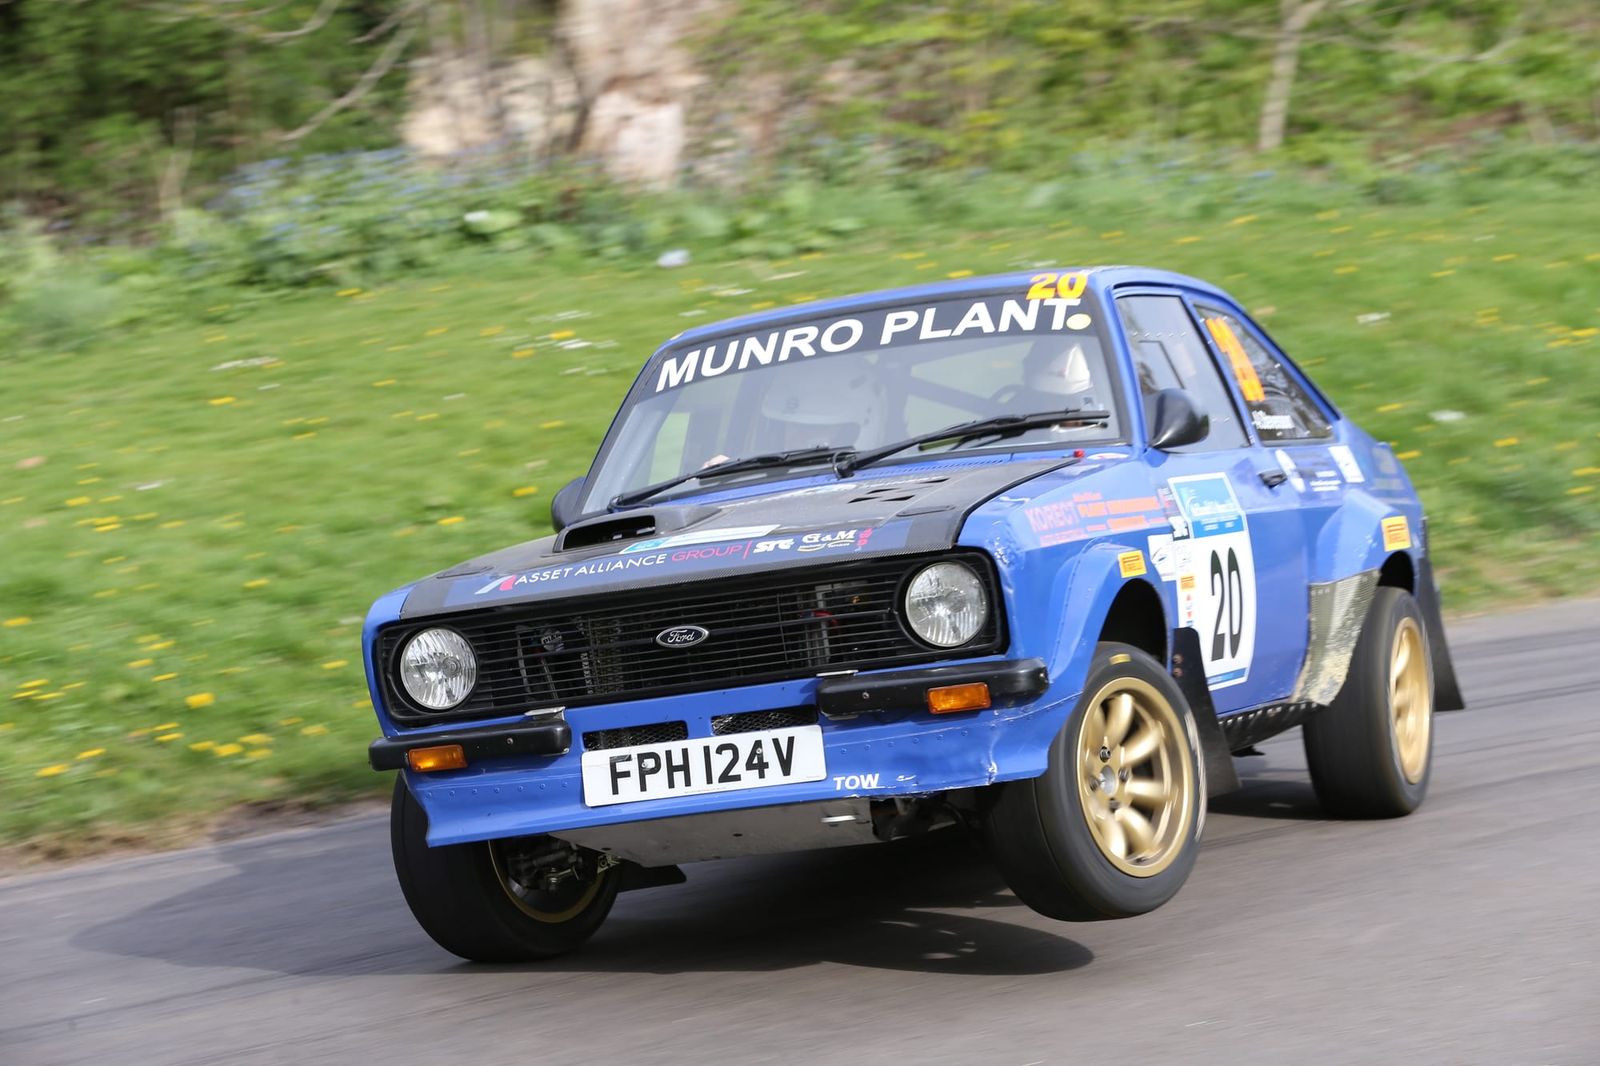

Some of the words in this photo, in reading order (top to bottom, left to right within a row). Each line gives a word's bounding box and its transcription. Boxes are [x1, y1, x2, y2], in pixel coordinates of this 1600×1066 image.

[1025, 272, 1088, 300] 20
[655, 318, 863, 393] MUNRO
[515, 567, 573, 586] ASSET
[574, 554, 666, 577] ALLIANCE
[672, 544, 743, 563] GROUP
[1210, 547, 1243, 662] 20
[667, 628, 695, 644] Ford
[609, 747, 691, 795] FPH
[703, 735, 795, 785] 124V
[833, 773, 880, 790] TOW
